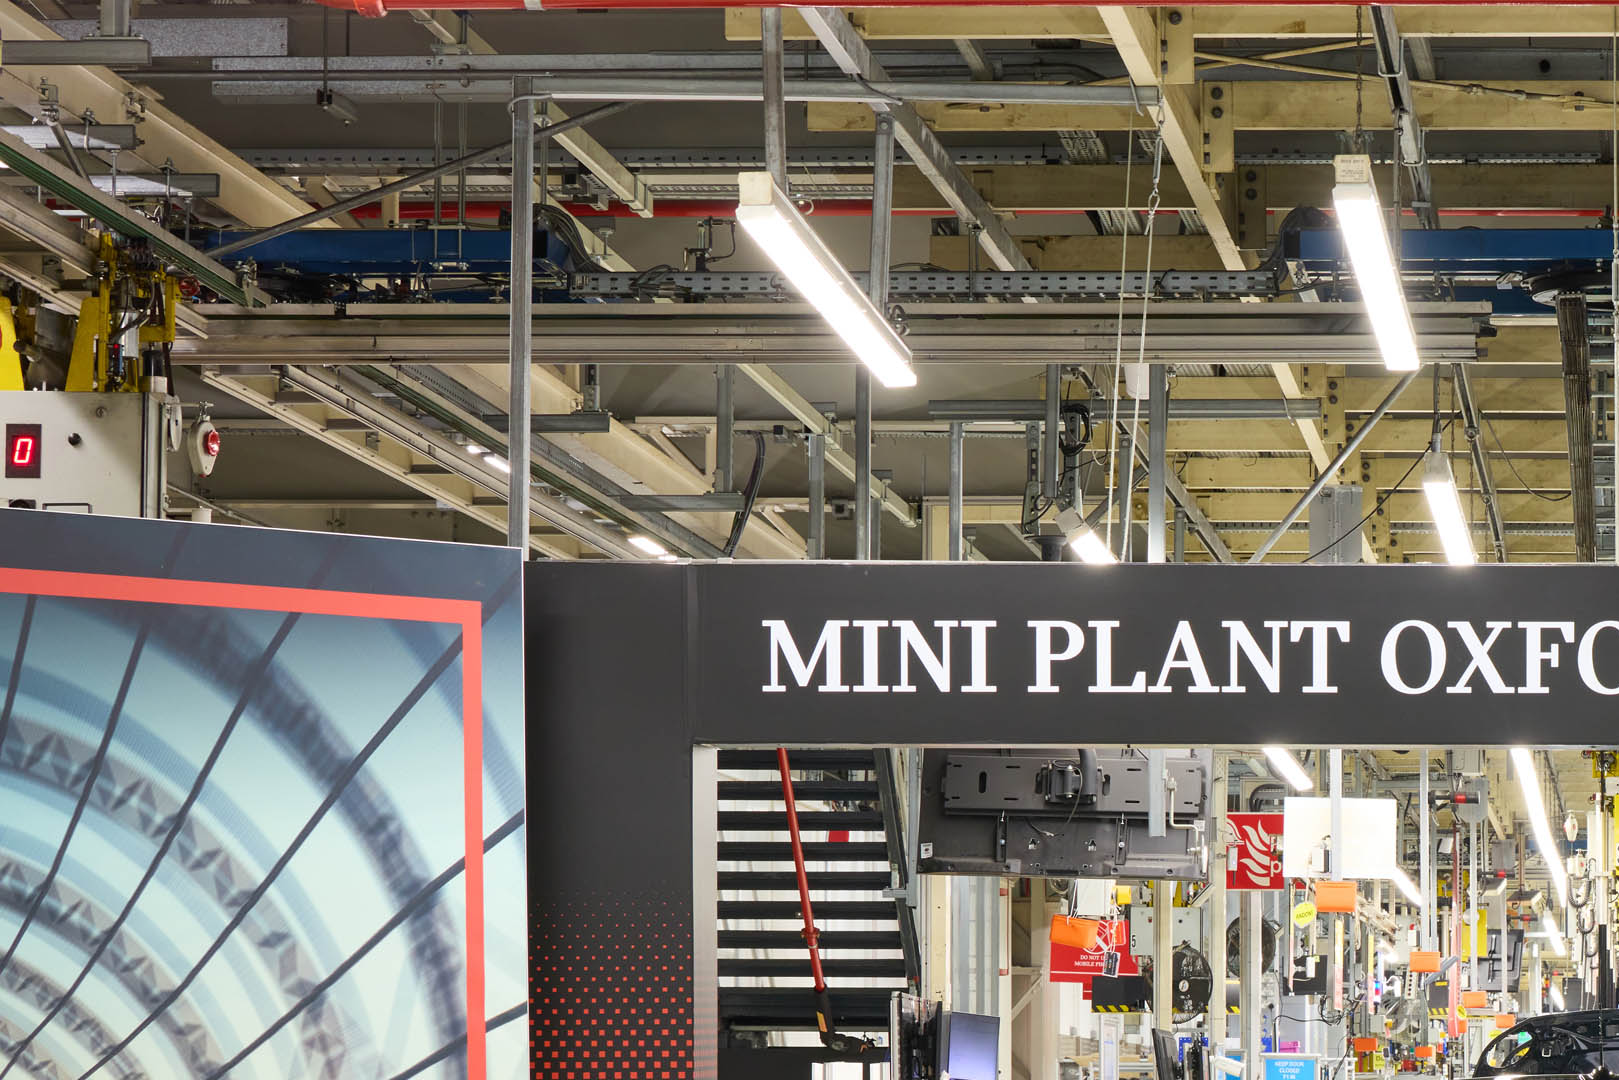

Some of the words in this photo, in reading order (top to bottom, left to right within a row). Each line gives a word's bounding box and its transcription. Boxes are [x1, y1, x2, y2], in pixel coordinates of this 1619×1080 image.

[14, 438, 33, 464] 0
[762, 620, 997, 693] MINI
[1027, 620, 1350, 694] PLANT
[1131, 935, 1136, 947] 5
